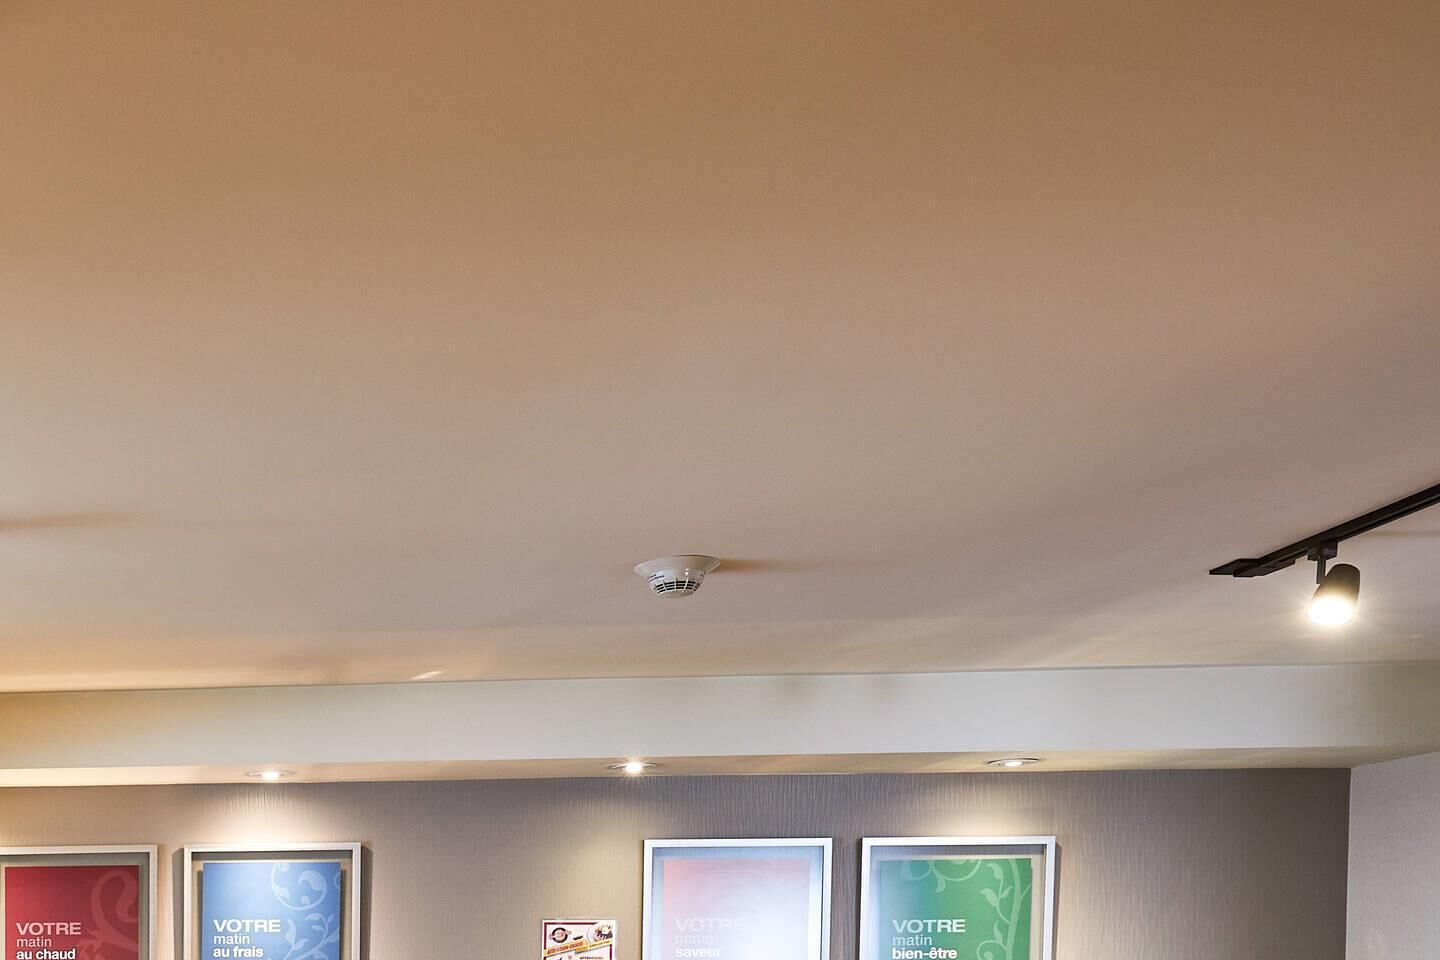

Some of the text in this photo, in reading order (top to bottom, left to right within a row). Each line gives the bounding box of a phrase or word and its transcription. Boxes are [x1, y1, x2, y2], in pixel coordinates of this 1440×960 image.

[16, 922, 82, 936] VOTRE
[213, 919, 281, 933] VOTRE
[674, 918, 745, 933] VOTRE
[892, 919, 966, 933] VOTRE
[16, 935, 52, 948] matin
[213, 933, 250, 945] matin
[675, 932, 714, 945] matin
[892, 933, 933, 946] matin
[16, 948, 76, 960] au chaud
[213, 945, 264, 958] au frais
[674, 946, 724, 958] saveur
[892, 946, 958, 960] bien-être
